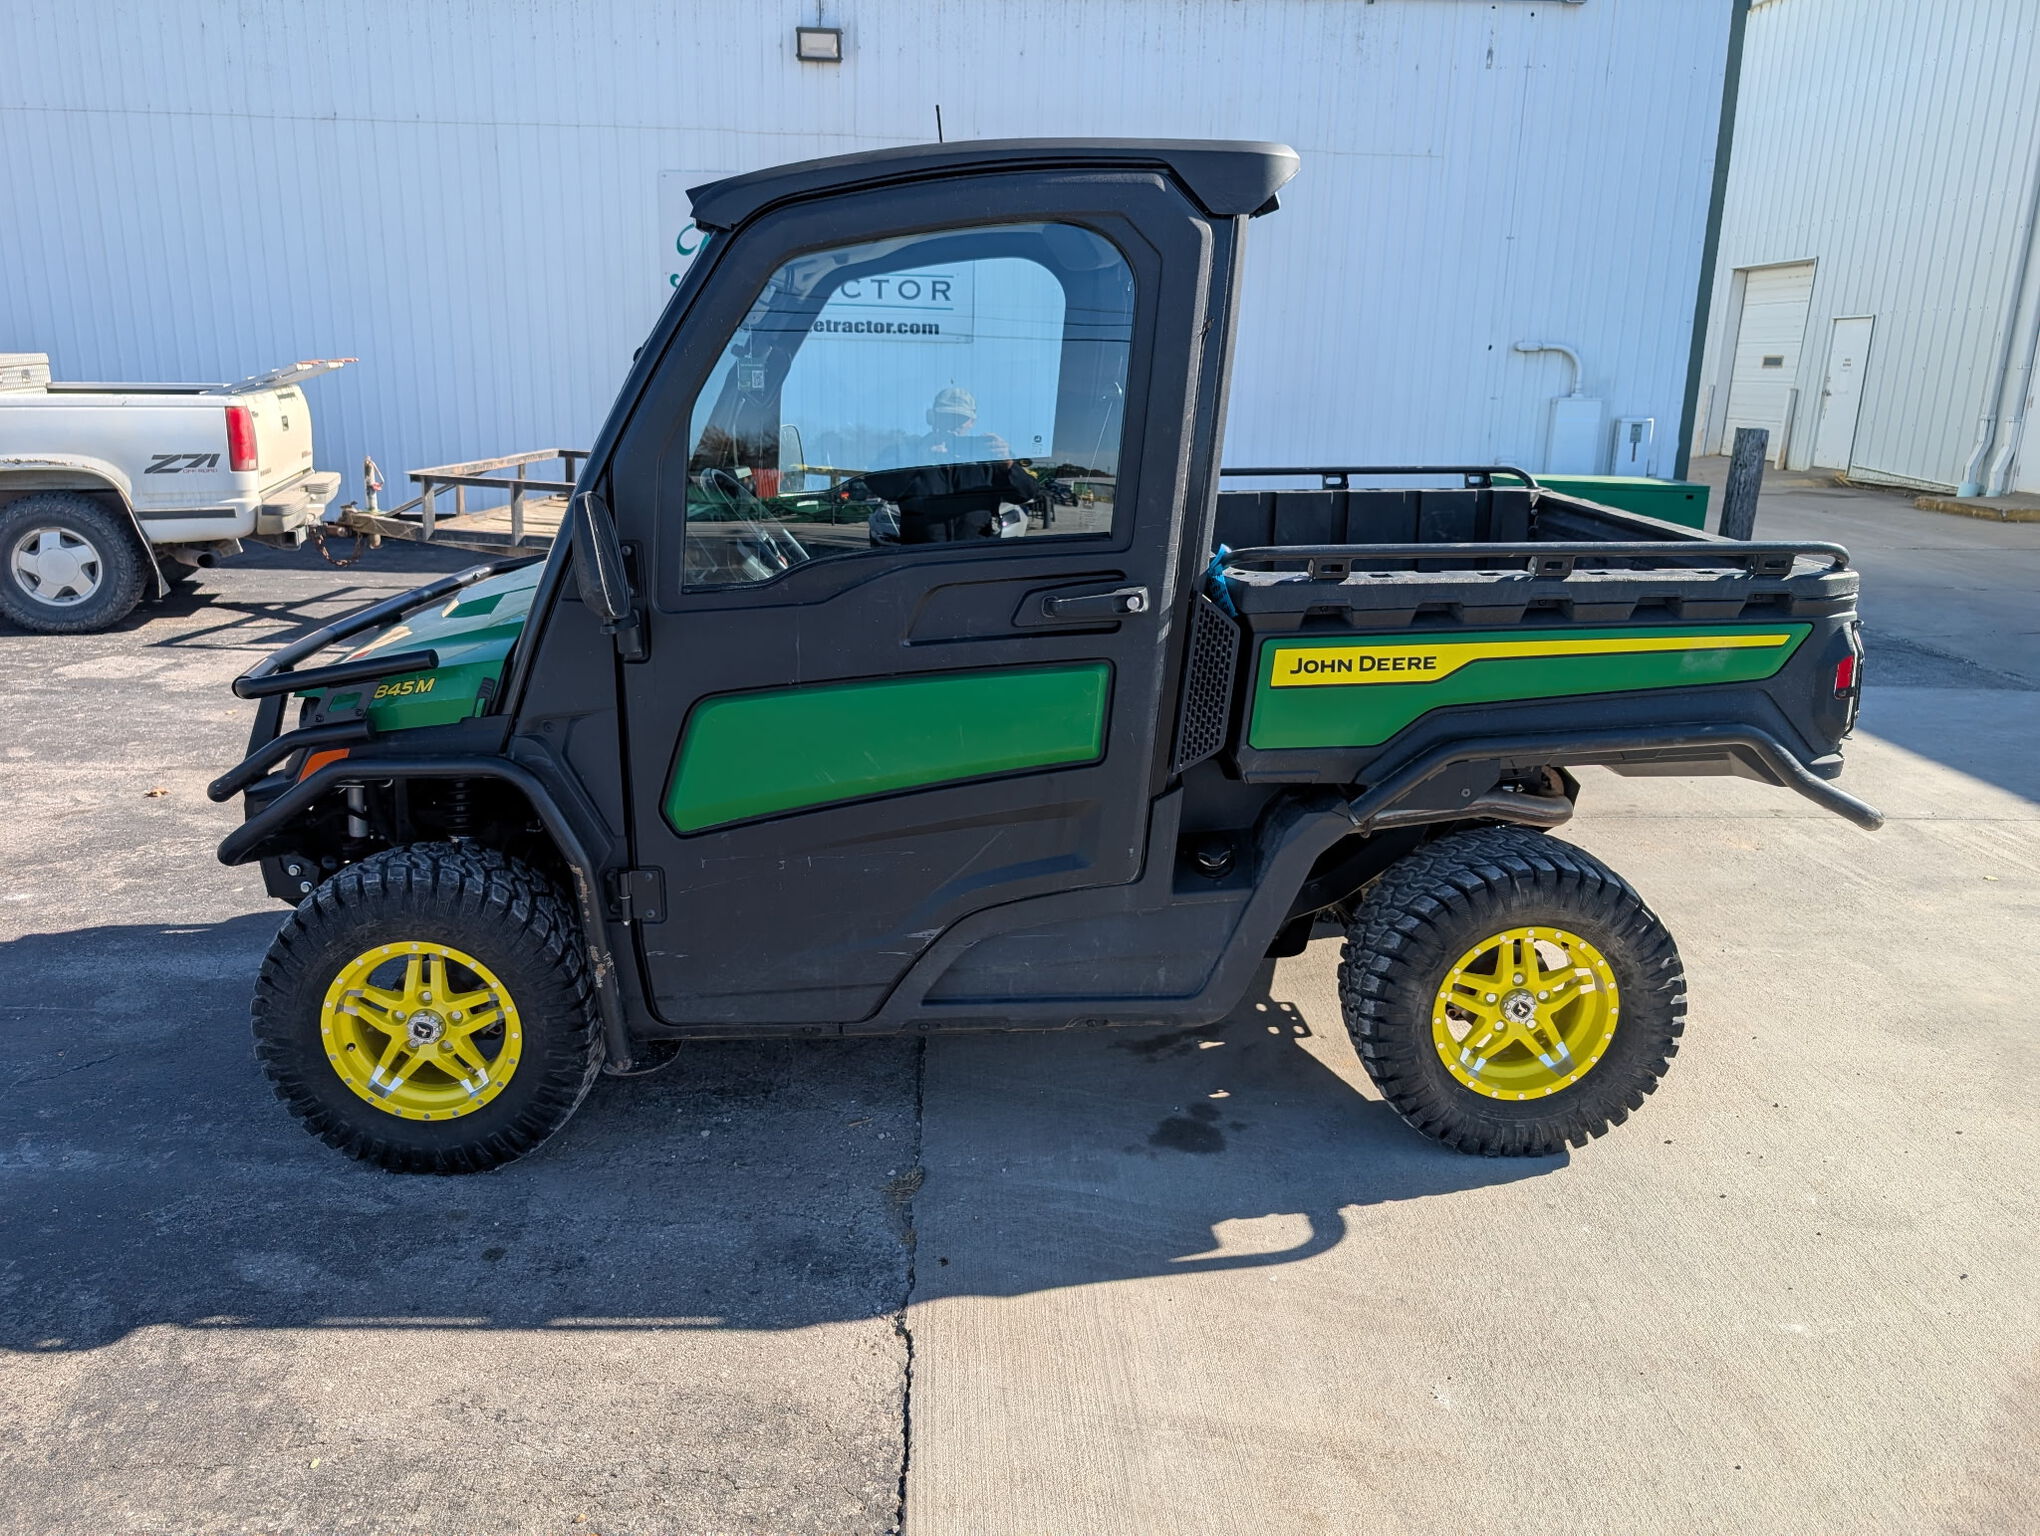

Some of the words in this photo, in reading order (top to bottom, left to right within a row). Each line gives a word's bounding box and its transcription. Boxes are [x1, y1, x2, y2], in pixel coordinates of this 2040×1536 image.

[810, 319, 940, 335] etractor.com
[144, 453, 221, 474] Z71
[1290, 657, 1353, 675] JOHN
[1359, 655, 1437, 672] DEERE
